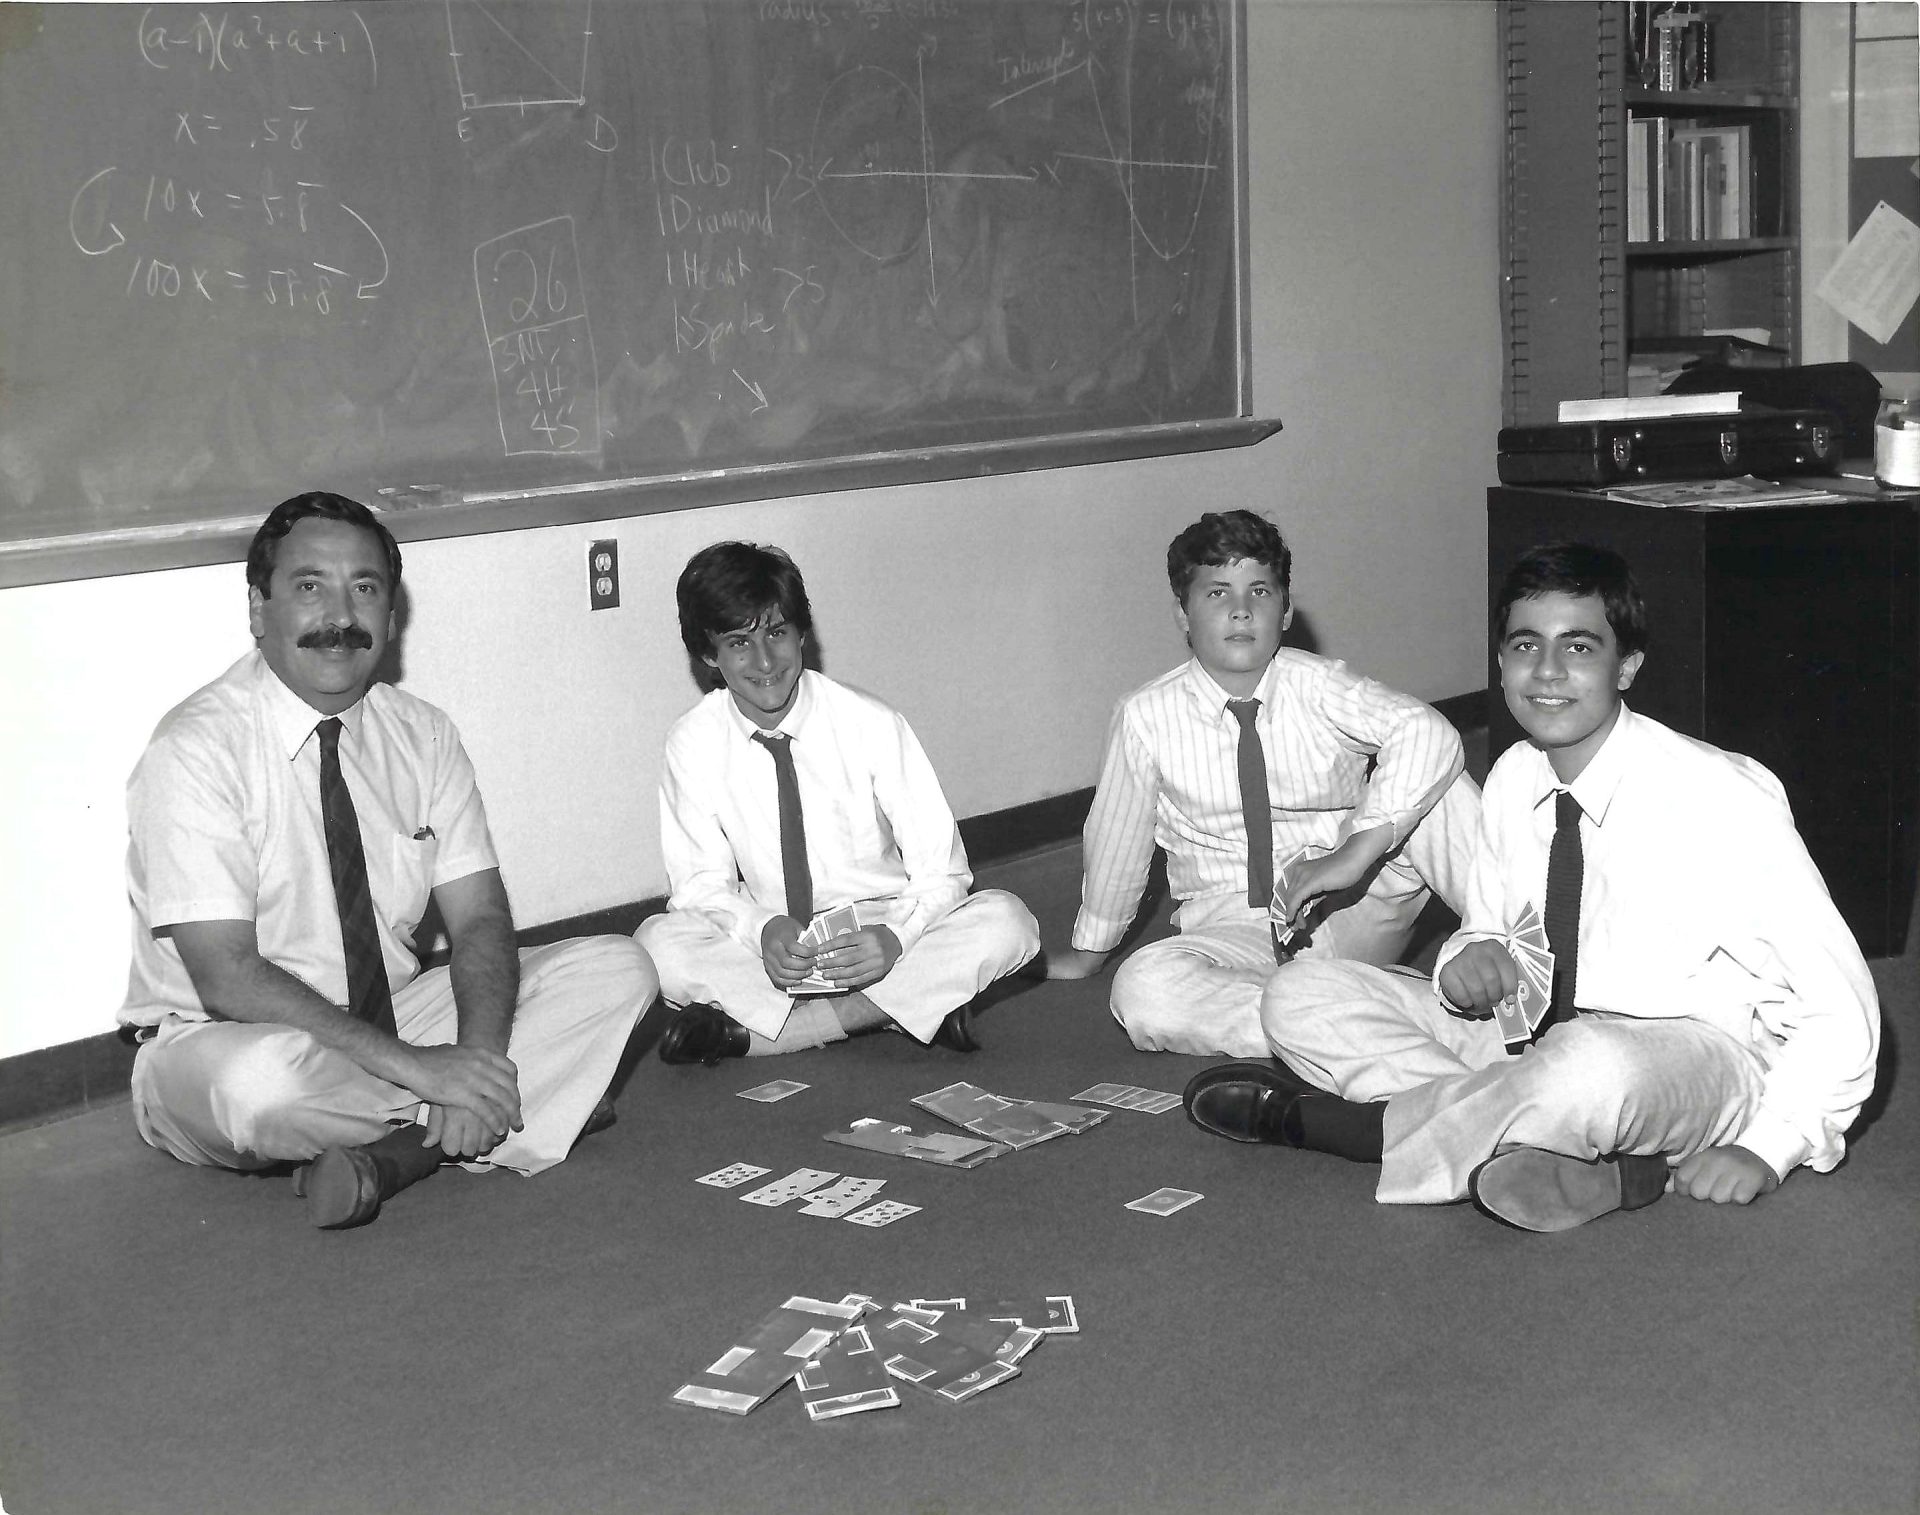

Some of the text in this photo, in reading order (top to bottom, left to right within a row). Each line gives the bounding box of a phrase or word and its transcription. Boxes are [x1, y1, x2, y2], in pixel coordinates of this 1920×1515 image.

[457, 116, 473, 143] E
[586, 113, 619, 153] D
[662, 135, 732, 188] Club
[671, 184, 776, 239] Diamond
[492, 246, 570, 323] 26
[682, 246, 753, 292] Heart
[679, 301, 777, 365] Spade
